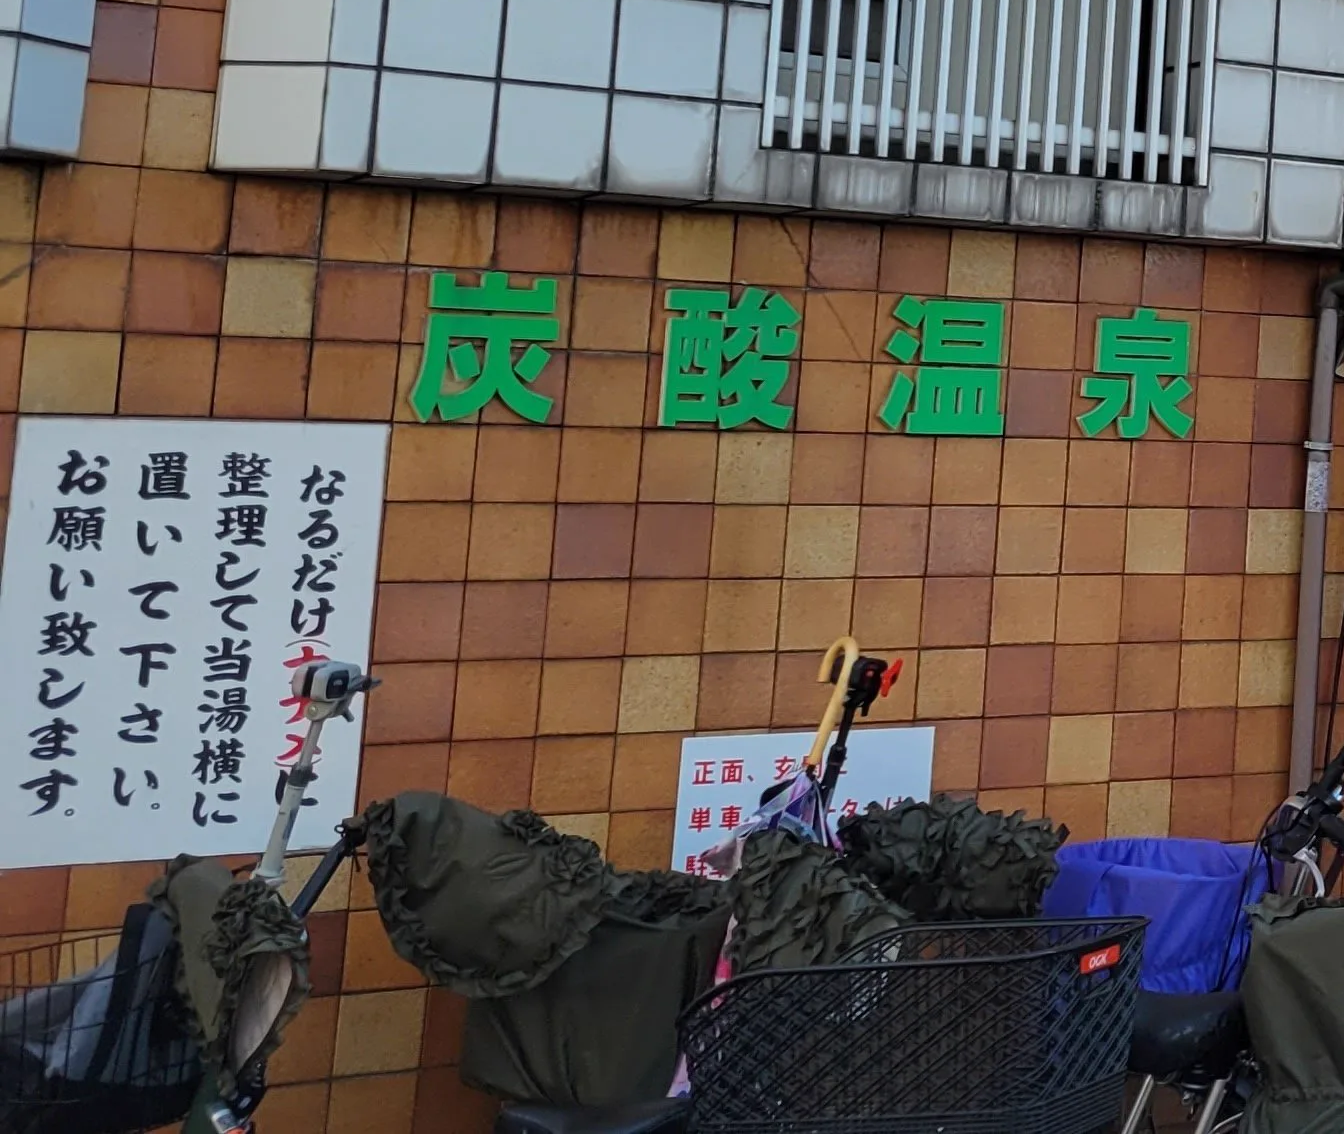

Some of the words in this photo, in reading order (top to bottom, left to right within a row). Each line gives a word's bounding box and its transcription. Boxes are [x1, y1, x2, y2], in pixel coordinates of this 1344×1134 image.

[406, 270, 1194, 440] 炭酸温泉
[19, 450, 111, 818] お願い致します。
[112, 452, 191, 811] 置いて下さい。
[191, 452, 272, 827] 整理して当湯横に
